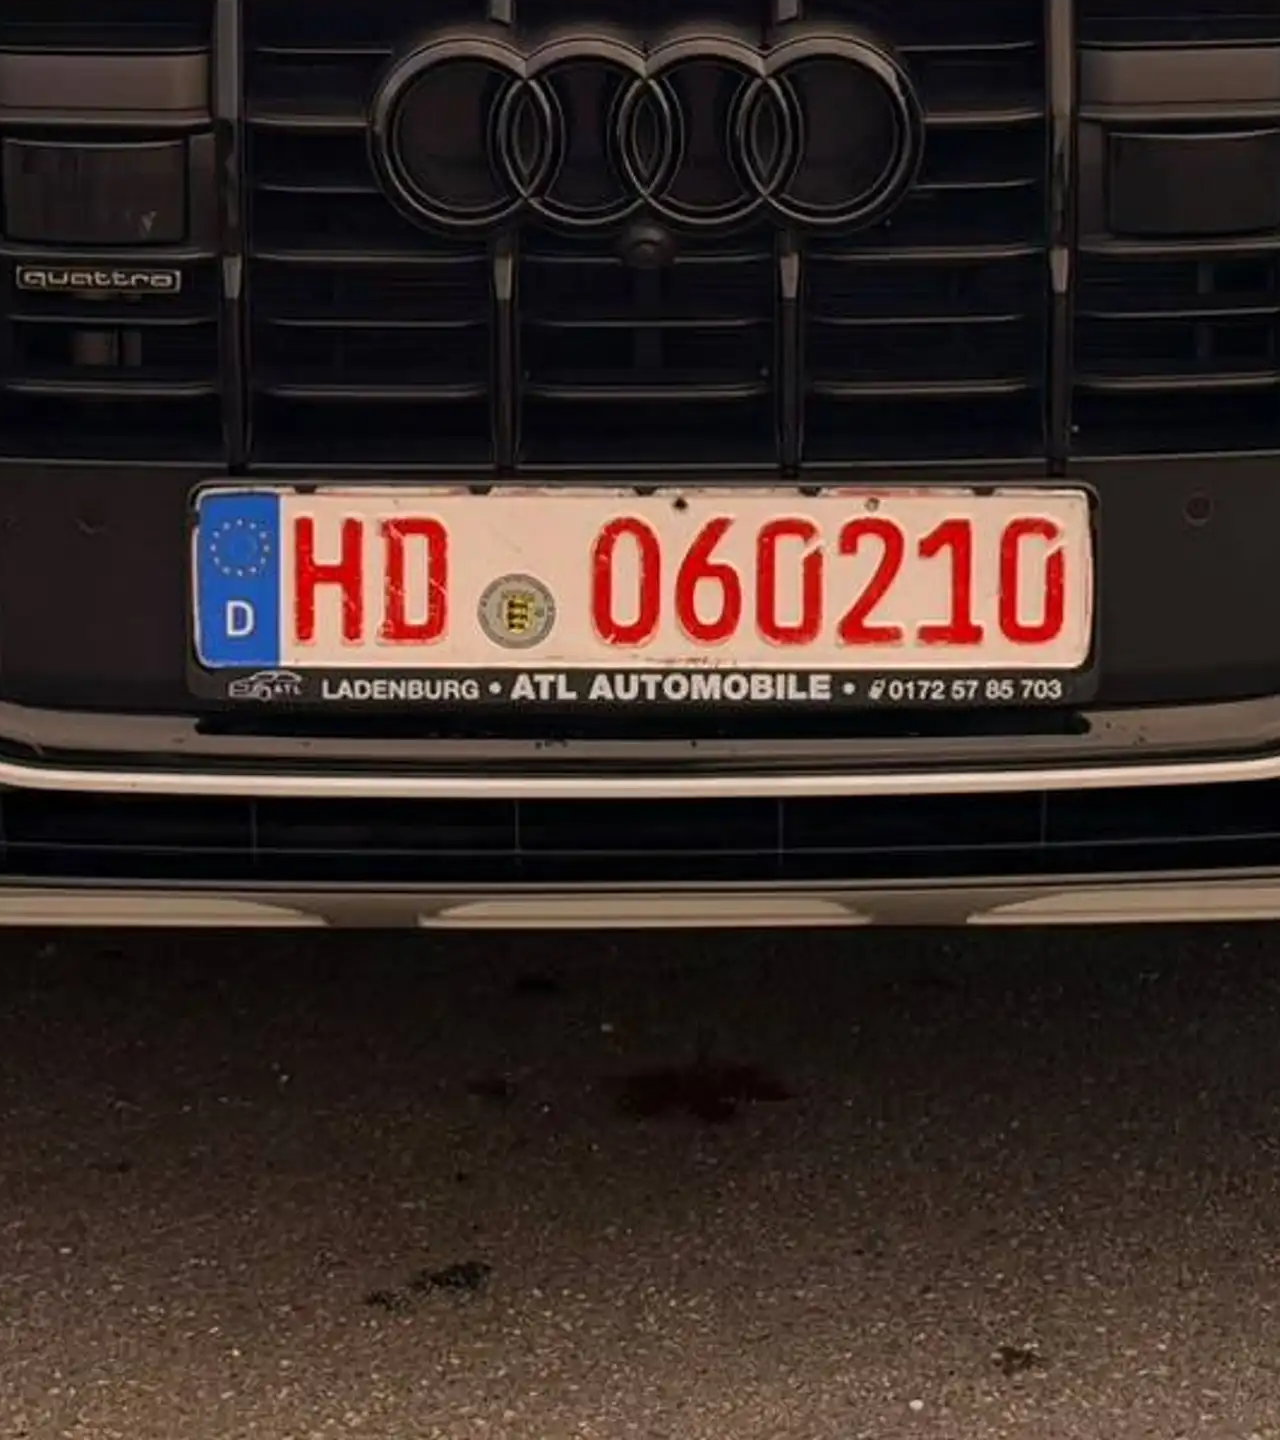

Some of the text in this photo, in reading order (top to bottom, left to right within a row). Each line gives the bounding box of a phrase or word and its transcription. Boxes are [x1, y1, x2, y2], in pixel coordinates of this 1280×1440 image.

[23, 270, 172, 288] quattro
[293, 516, 449, 642] HD
[590, 516, 1065, 645] 060210
[225, 600, 255, 637] D
[321, 672, 1063, 701] LADENBURG ATL AUTOMOBILE 0172 57 85 703
